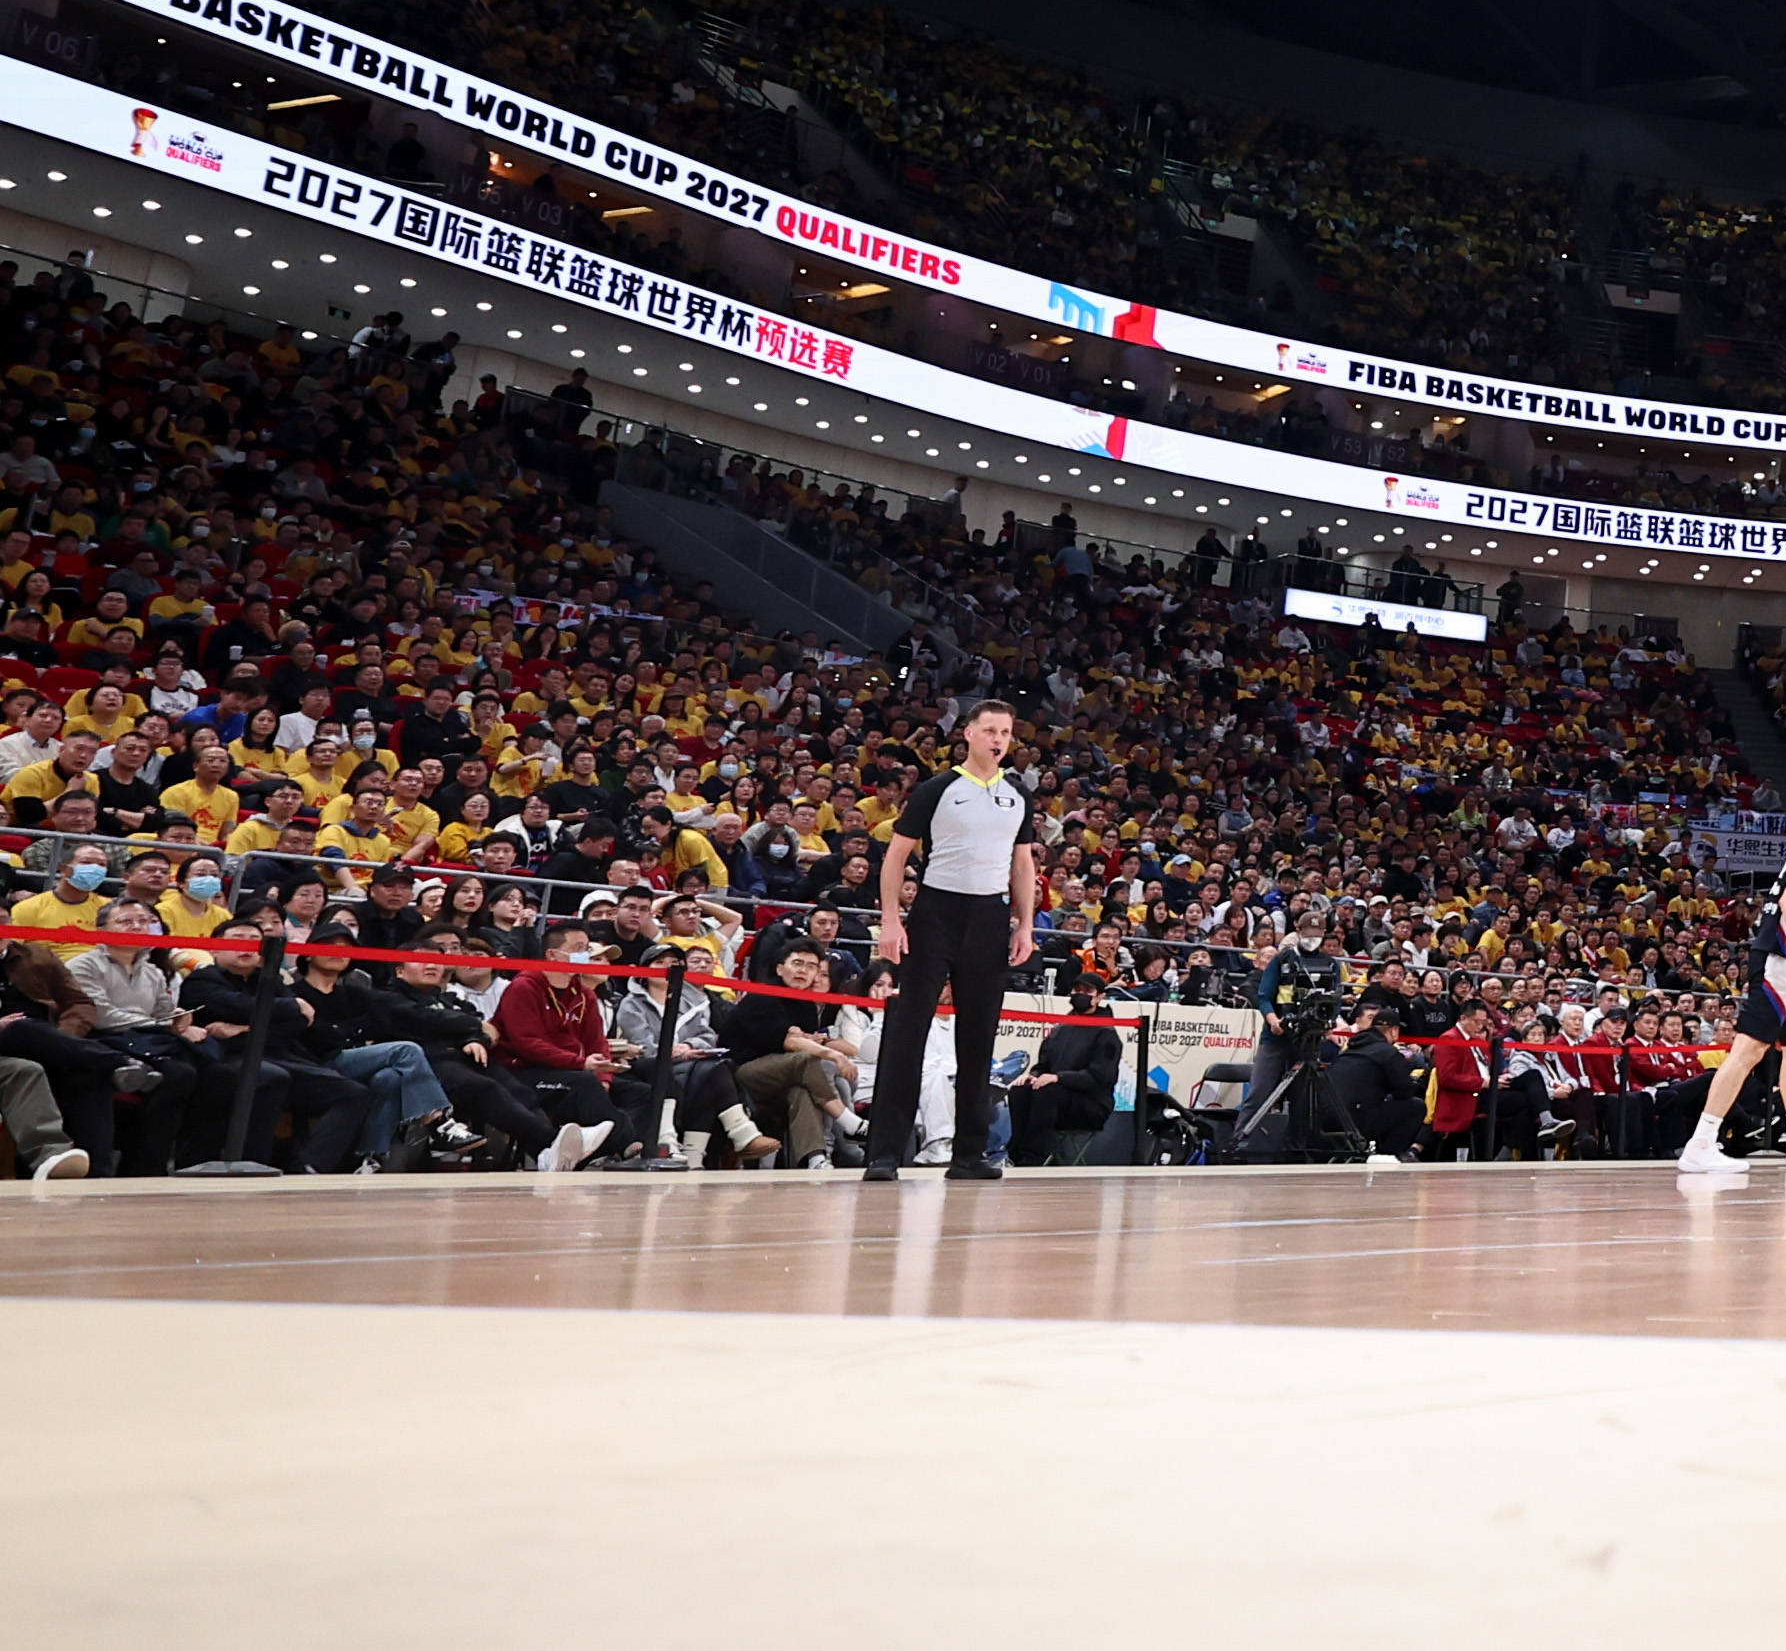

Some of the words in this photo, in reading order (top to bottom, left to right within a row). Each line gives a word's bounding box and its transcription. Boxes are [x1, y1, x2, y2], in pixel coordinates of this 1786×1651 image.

[44, 31, 79, 61] 06
[165, 146, 222, 172] QUALIFIERS
[168, 138, 203, 155] WORLD
[205, 149, 224, 161] CUP
[465, 85, 597, 159] WORLD
[604, 140, 679, 186] CUP
[684, 170, 770, 223] 2027
[776, 205, 962, 286] QUALIFIERS
[262, 155, 854, 380] 2027国际篮联篮球世界杯预选赛
[1348, 360, 1417, 394] FIBA
[1425, 374, 1617, 425] BASKETBALL
[1624, 405, 1725, 437] WORLD
[1016, 1025, 1041, 1038] 2027
[1126, 1032, 1158, 1045] WOLD
[1159, 1034, 1178, 1046] CUP
[1179, 1035, 1202, 1047] 2027
[1203, 1036, 1253, 1048] QUALIFIERS
[1174, 1021, 1230, 1035] BASKETBALL
